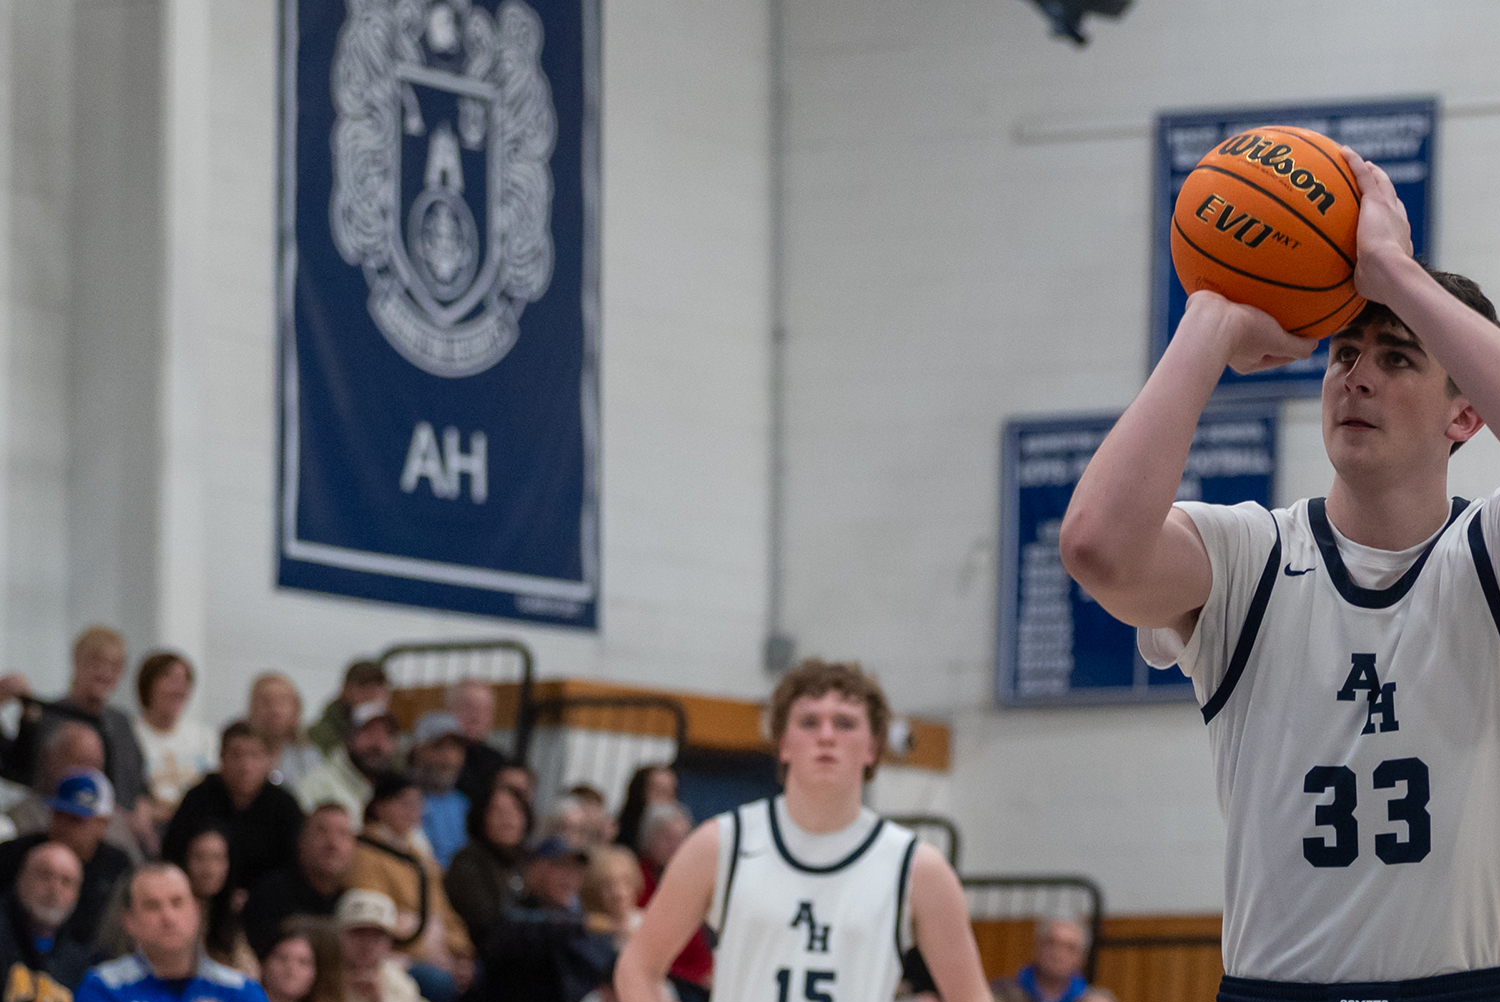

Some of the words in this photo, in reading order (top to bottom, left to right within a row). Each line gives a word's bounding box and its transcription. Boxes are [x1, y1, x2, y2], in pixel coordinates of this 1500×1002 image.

[1218, 134, 1335, 216] Wilson
[1195, 193, 1274, 249] EVO
[1272, 231, 1302, 250] NXT
[400, 420, 488, 505] AH
[1303, 757, 1431, 868] 33
